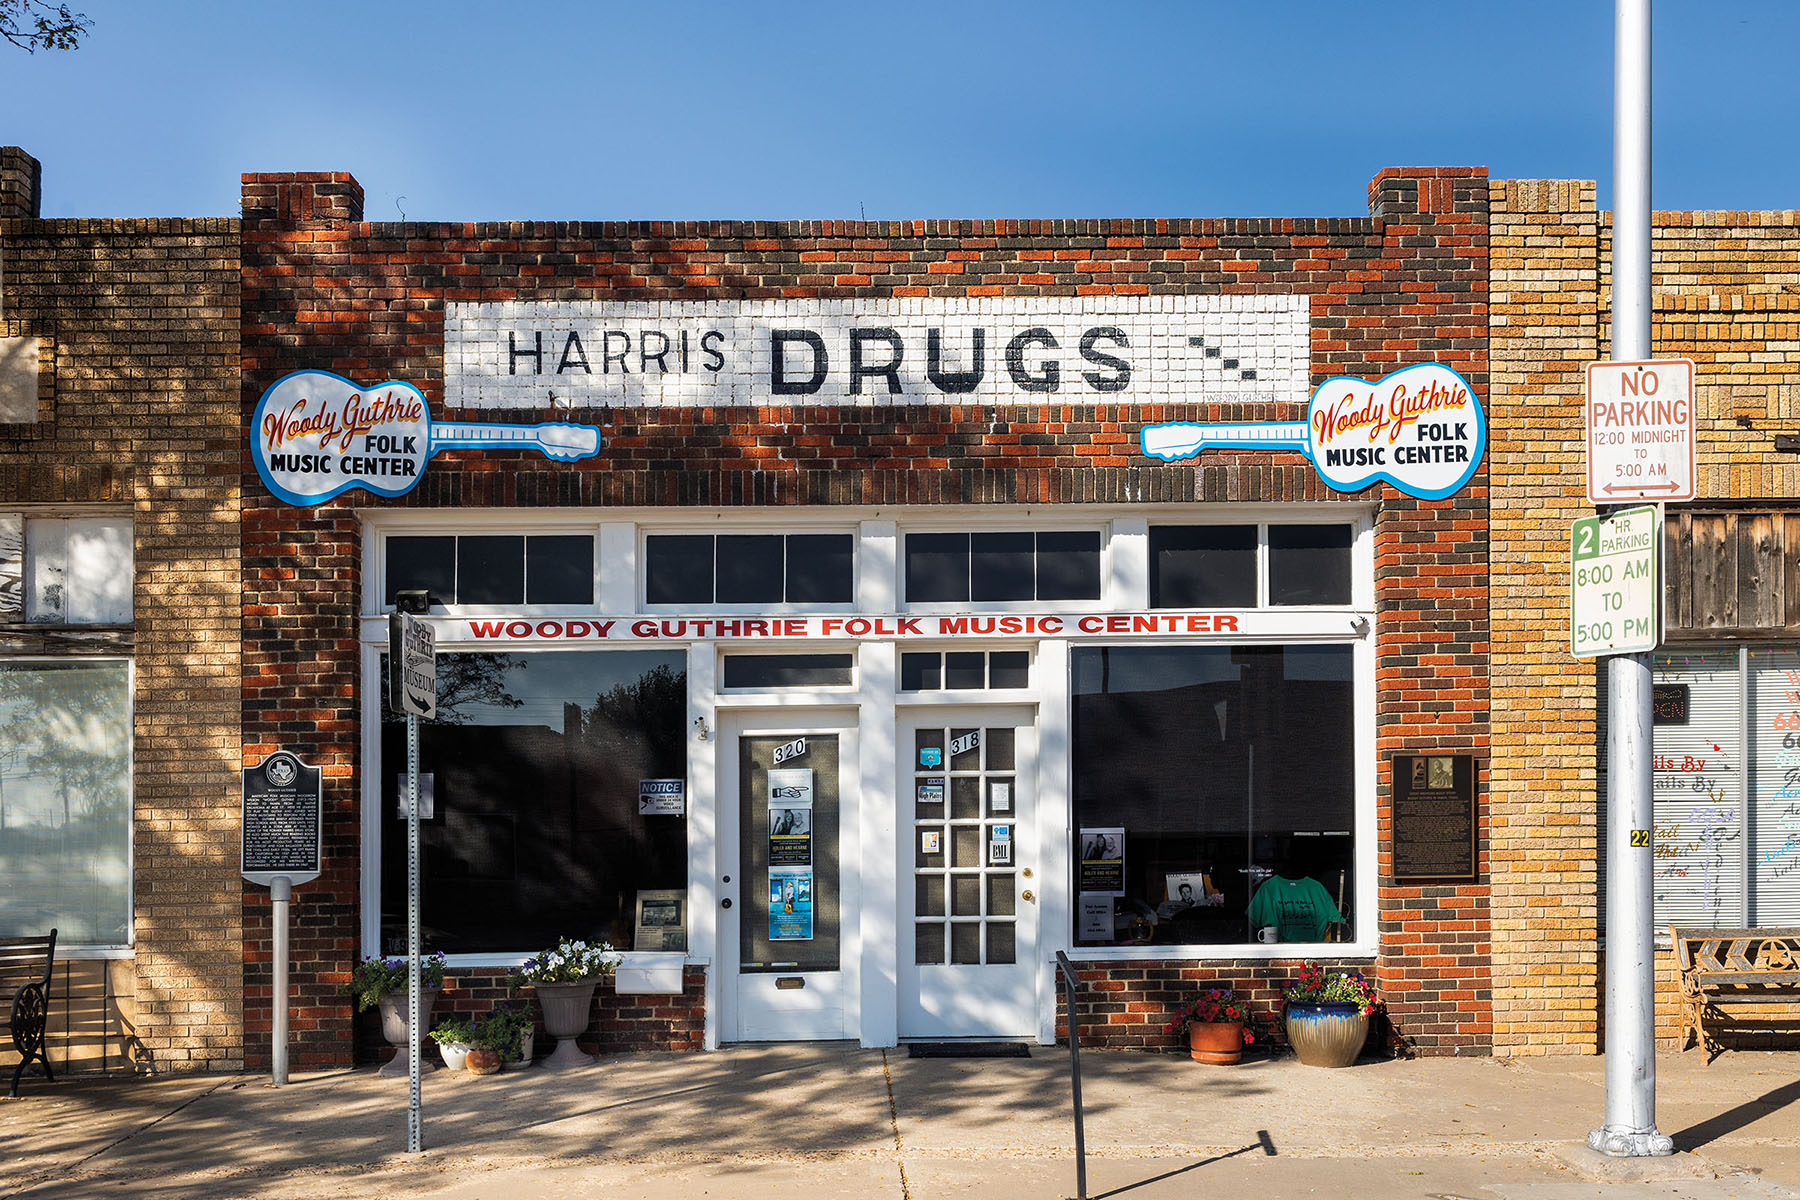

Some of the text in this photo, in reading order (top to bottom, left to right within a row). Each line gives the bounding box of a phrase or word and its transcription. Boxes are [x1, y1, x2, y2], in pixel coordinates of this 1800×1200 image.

[508, 326, 1132, 396] HARRIS DRUGS
[1622, 370, 1659, 396] NO
[264, 392, 422, 454] Woody Guthrie
[1314, 379, 1466, 446] Woody Guthrie
[1593, 400, 1687, 427] PARKING
[1418, 422, 1468, 442] FOLK
[1594, 430, 1686, 445] 12:00 MIDNIGHT
[365, 434, 417, 454] FOLK
[1634, 448, 1647, 459] TO
[270, 454, 416, 476] MUSIC CENTER
[1326, 445, 1469, 467] MUSIC CENTER
[1616, 463, 1667, 477] 5:00 AM
[1578, 526, 1593, 554] 2
[1601, 533, 1649, 552] PARKING
[1578, 559, 1649, 586] 8:00 AM
[1602, 592, 1622, 611] TO
[469, 615, 1239, 639] WOODY GUTHRIE FOLK MUSIC CENTER
[1578, 617, 1649, 643] 5:00 PM
[403, 667, 434, 694] MUSEUM
[775, 739, 804, 762] 320
[952, 732, 978, 754] 318
[1681, 756, 1706, 772] By
[641, 783, 680, 792] NOTICE
[1631, 830, 1649, 846] 22
[993, 844, 1007, 857] BMI
